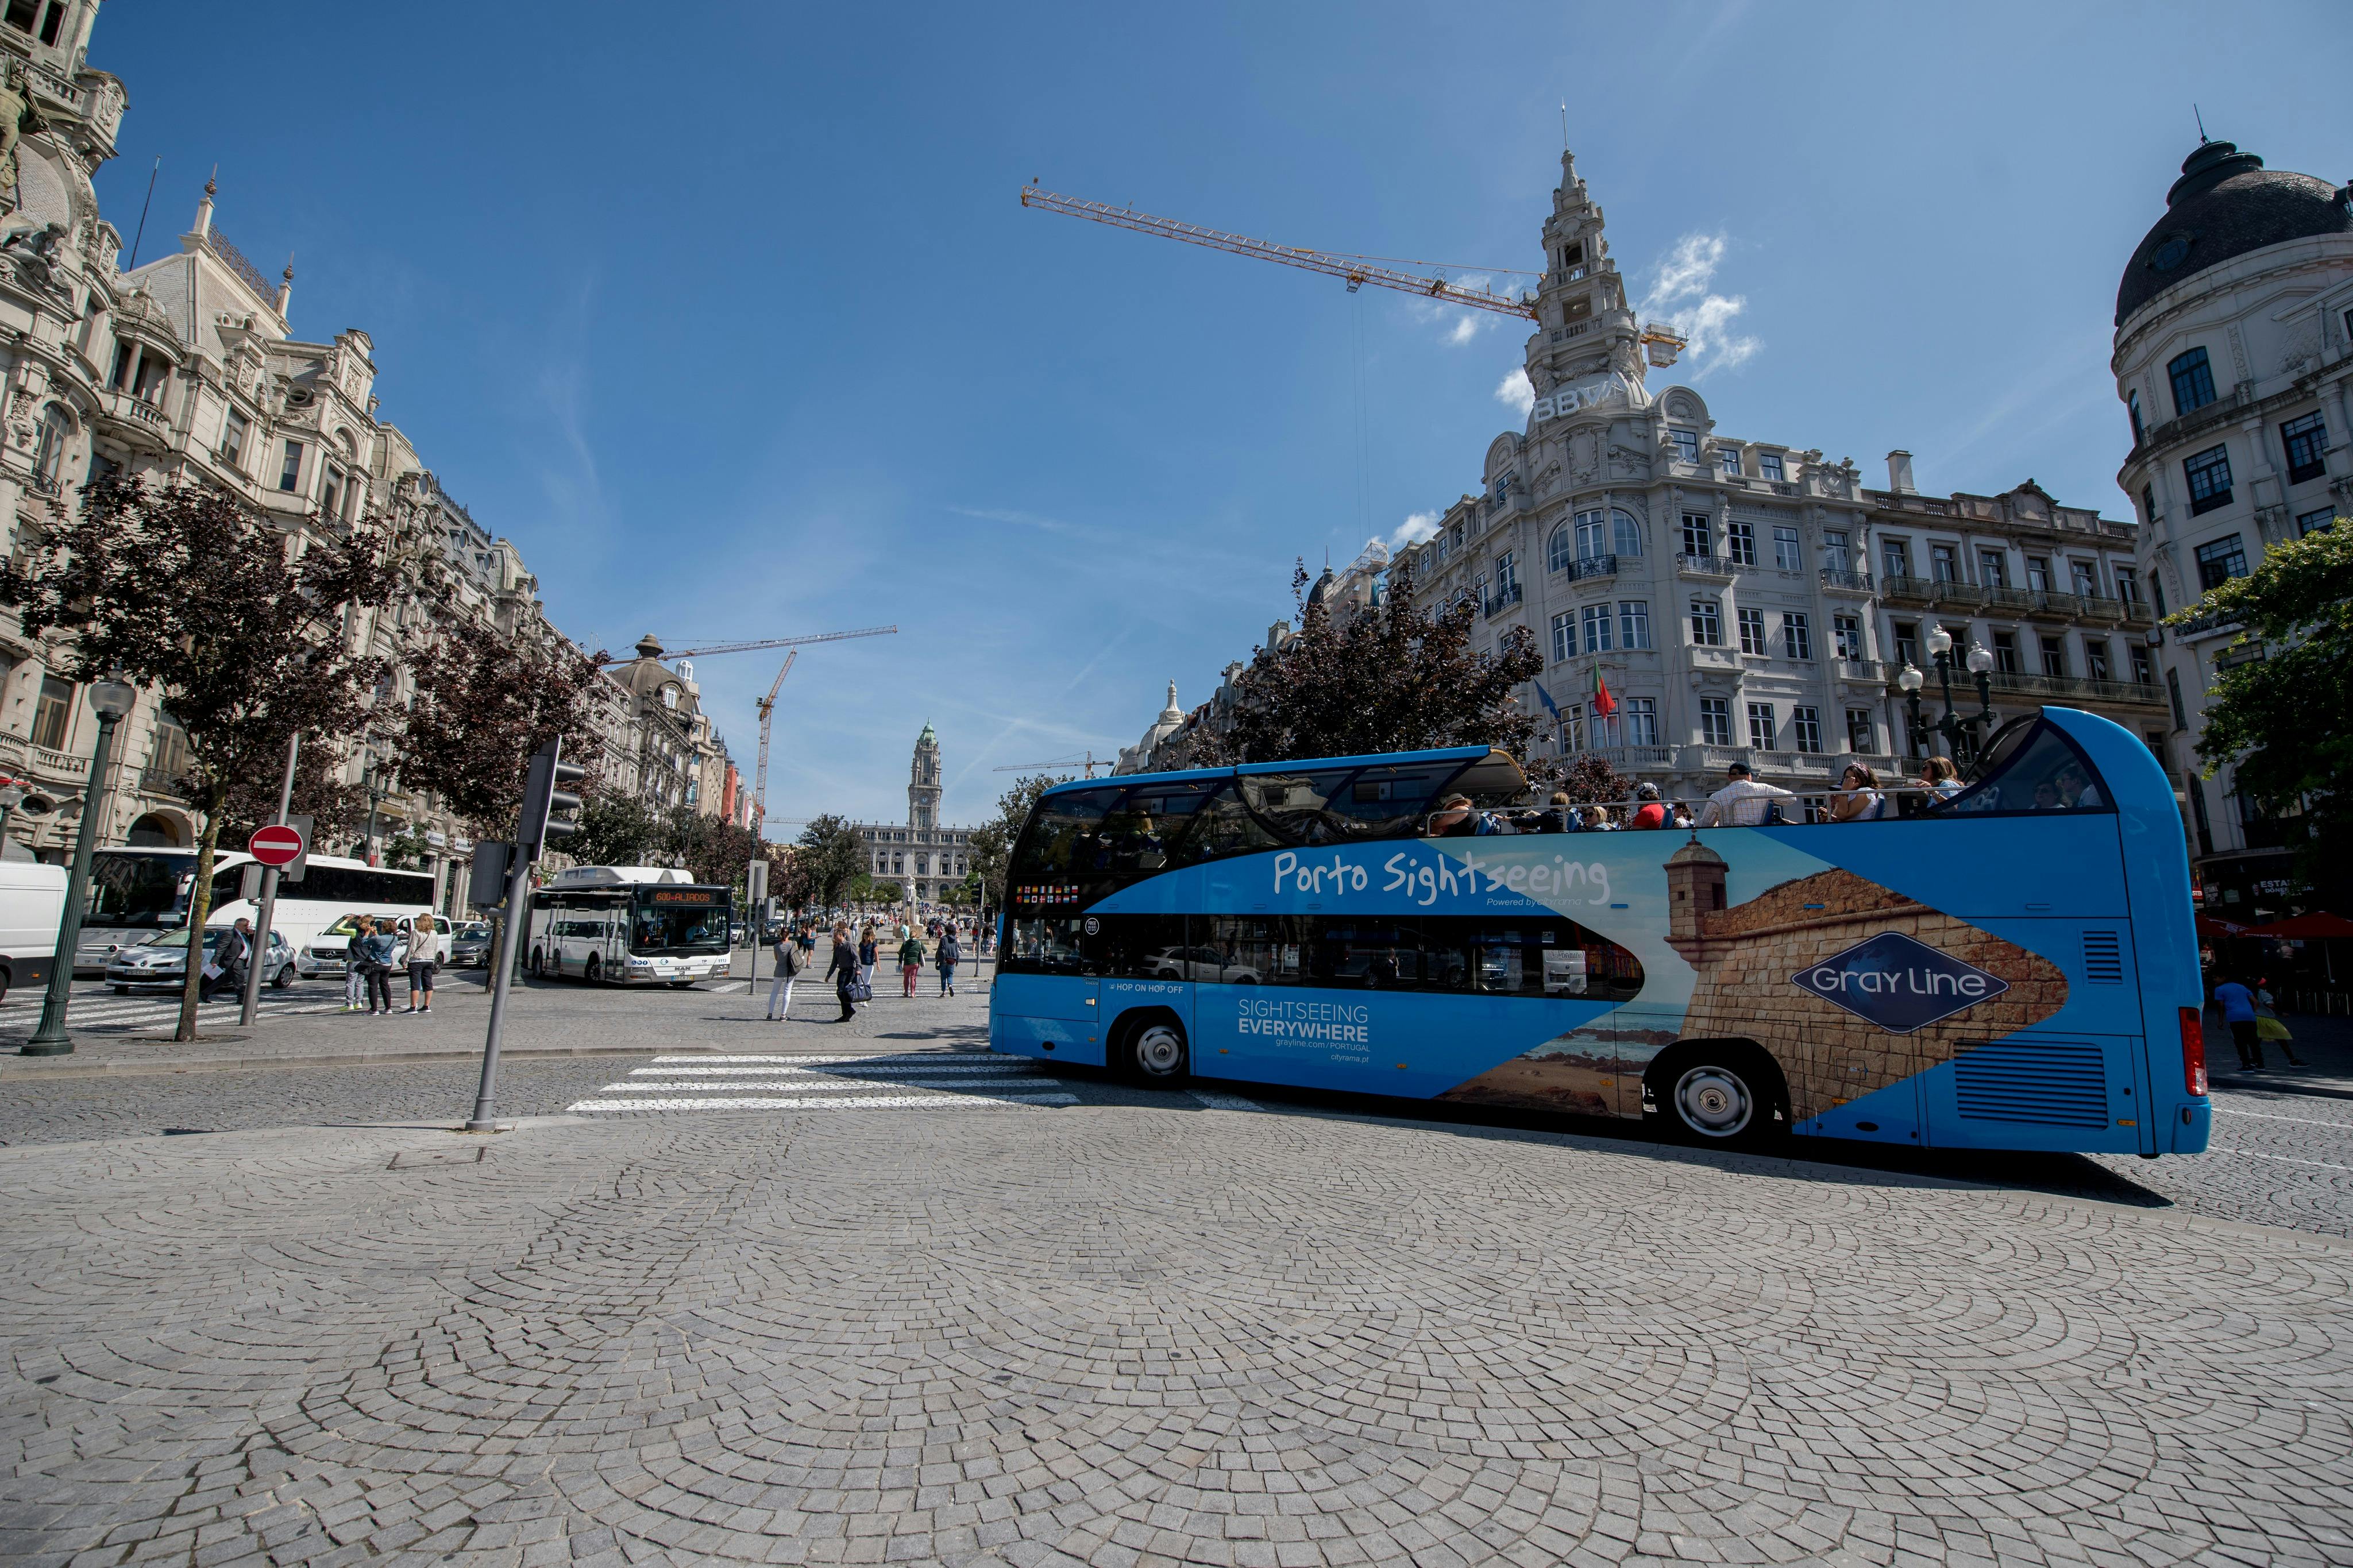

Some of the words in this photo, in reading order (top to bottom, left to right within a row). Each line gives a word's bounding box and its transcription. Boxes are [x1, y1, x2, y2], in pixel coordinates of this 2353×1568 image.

[1533, 372, 1629, 423] BBVA
[1274, 851, 1368, 895] Porto
[1383, 851, 1611, 906] Sightseeing
[1526, 898, 1537, 907] by
[1537, 897, 1581, 907] cityrama
[1135, 984, 1146, 992] ON
[1149, 984, 1165, 992] HOP
[1167, 986, 1183, 994] OFF
[1812, 967, 1901, 993] Gray
[1908, 968, 1986, 996] Line
[1239, 999, 1368, 1024] SIGHTSEEING
[1239, 1018, 1368, 1042] EVERYWHERE
[1331, 1053, 1369, 1064] cityrama.pt
